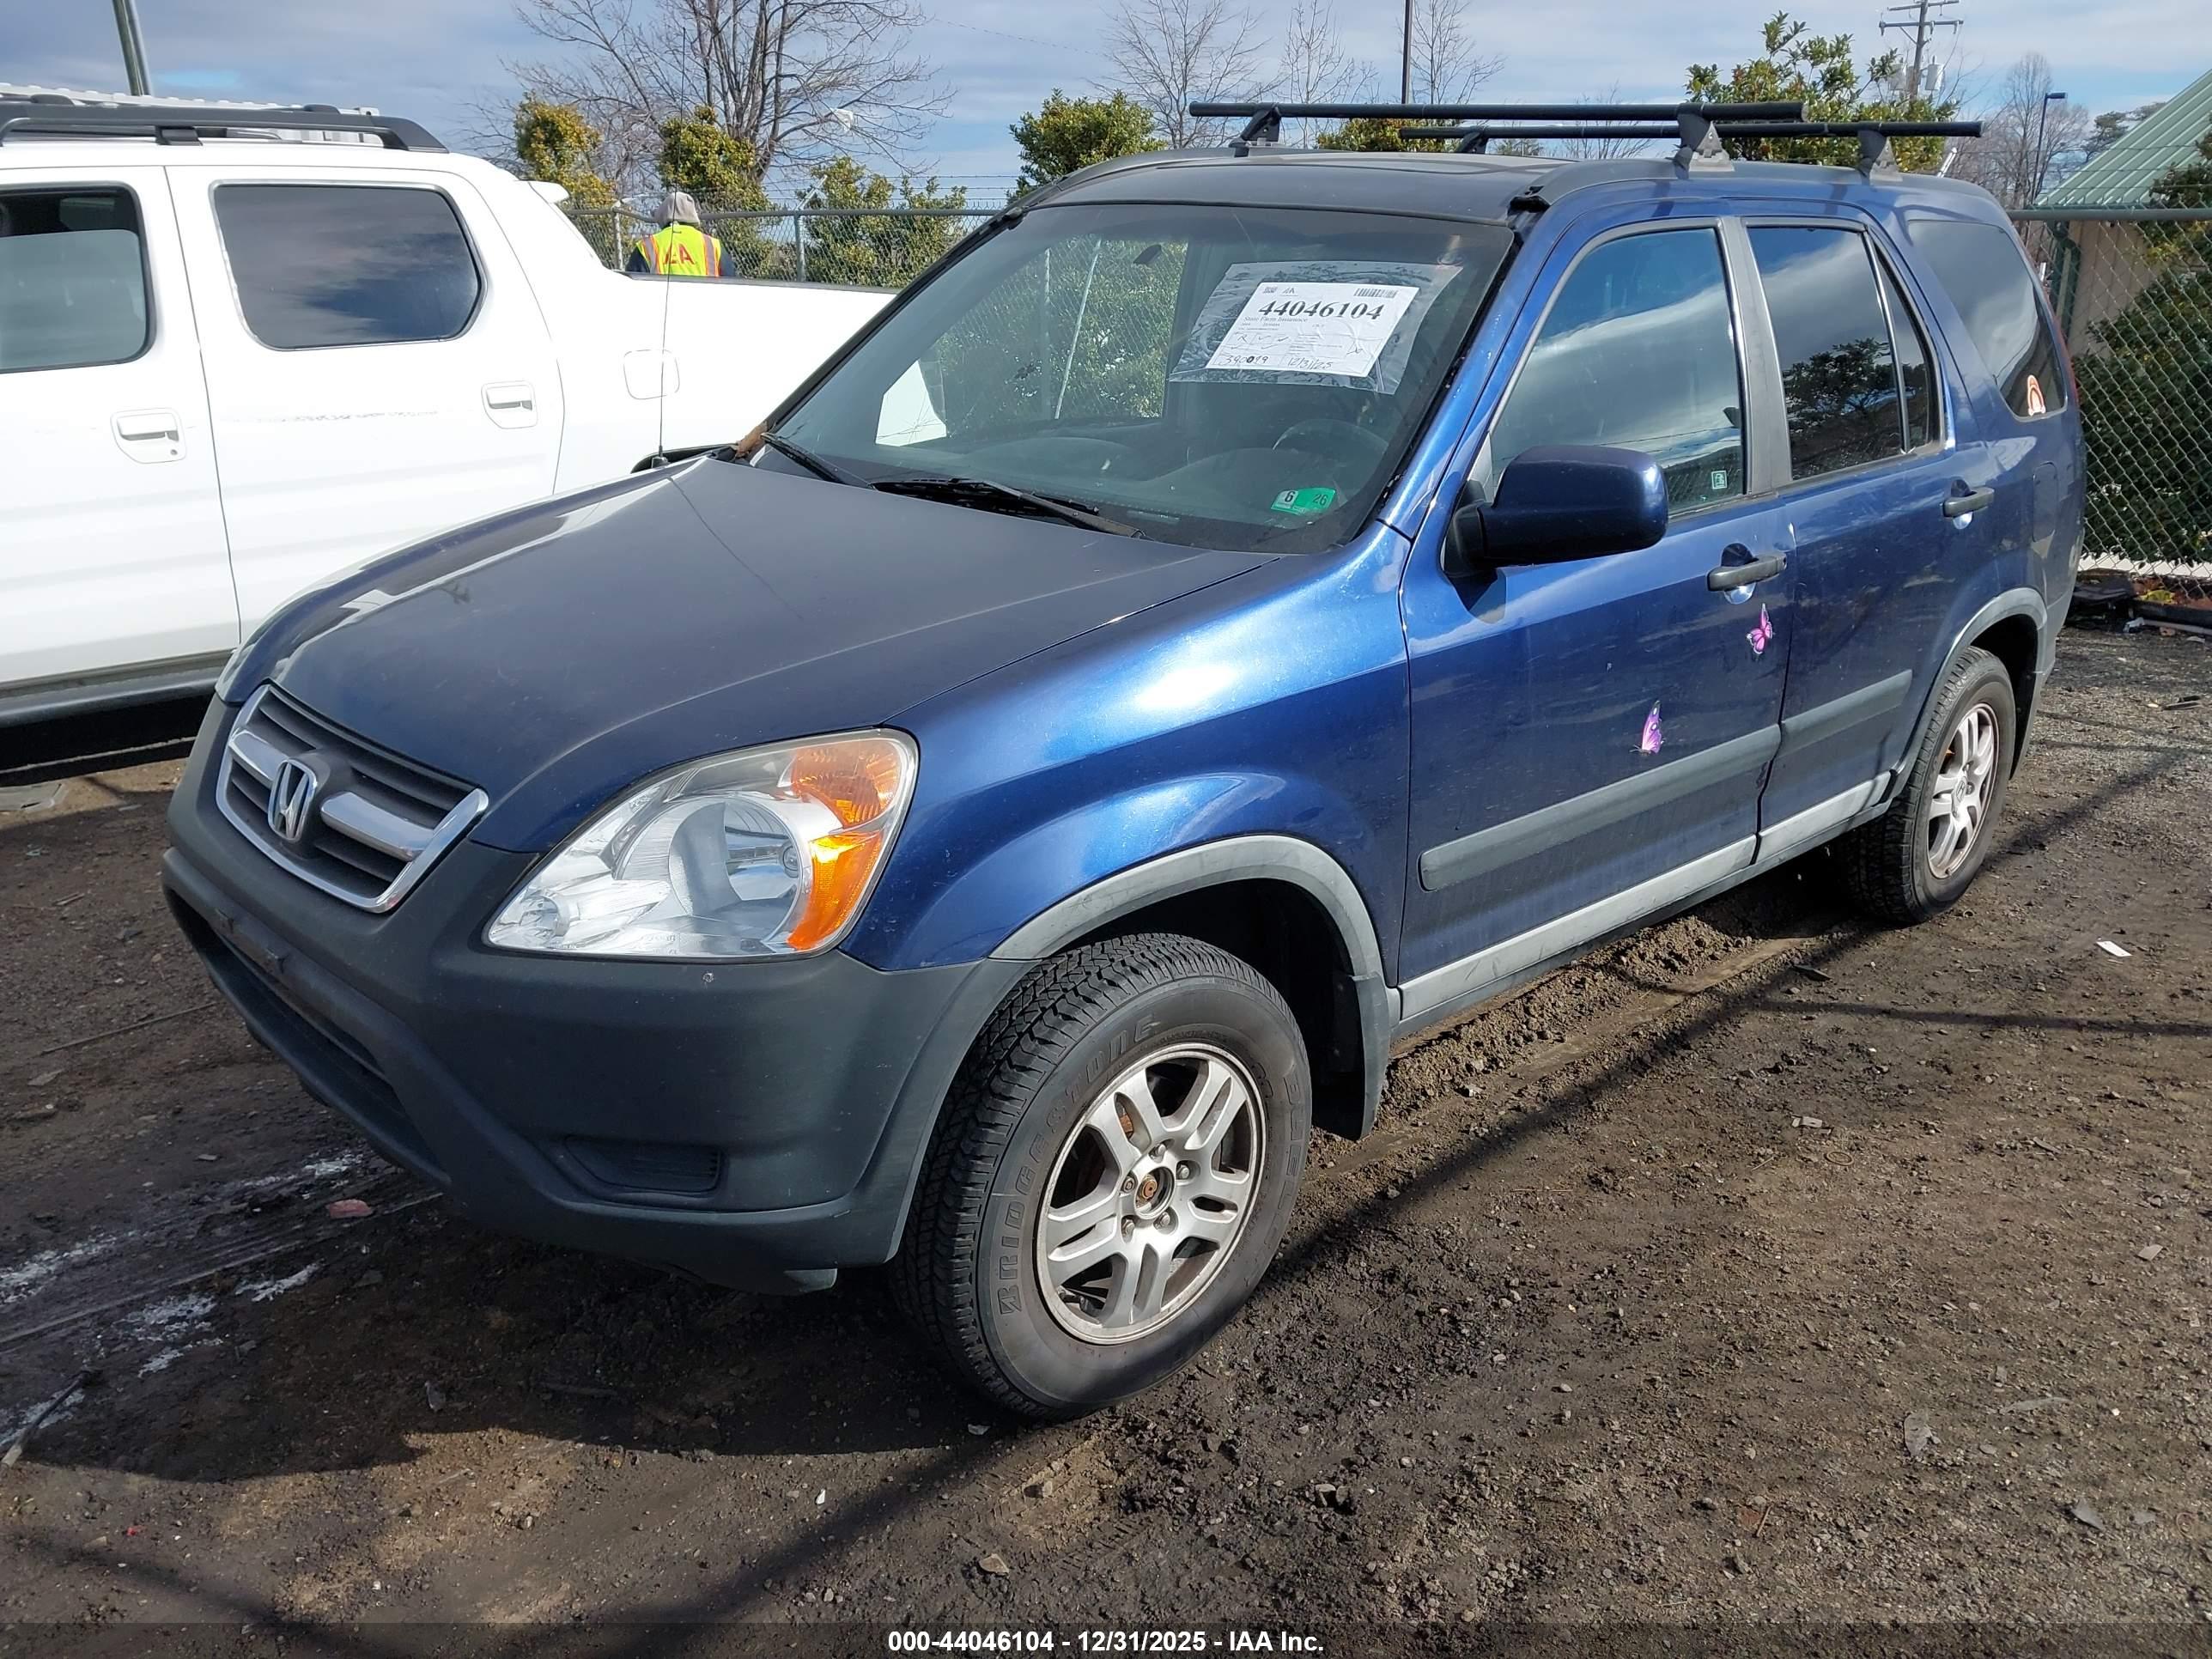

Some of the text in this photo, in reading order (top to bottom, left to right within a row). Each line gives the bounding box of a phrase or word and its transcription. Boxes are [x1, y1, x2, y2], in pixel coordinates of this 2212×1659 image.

[1258, 301, 1384, 319] 44046104
[1285, 490, 1328, 506] 6 26
